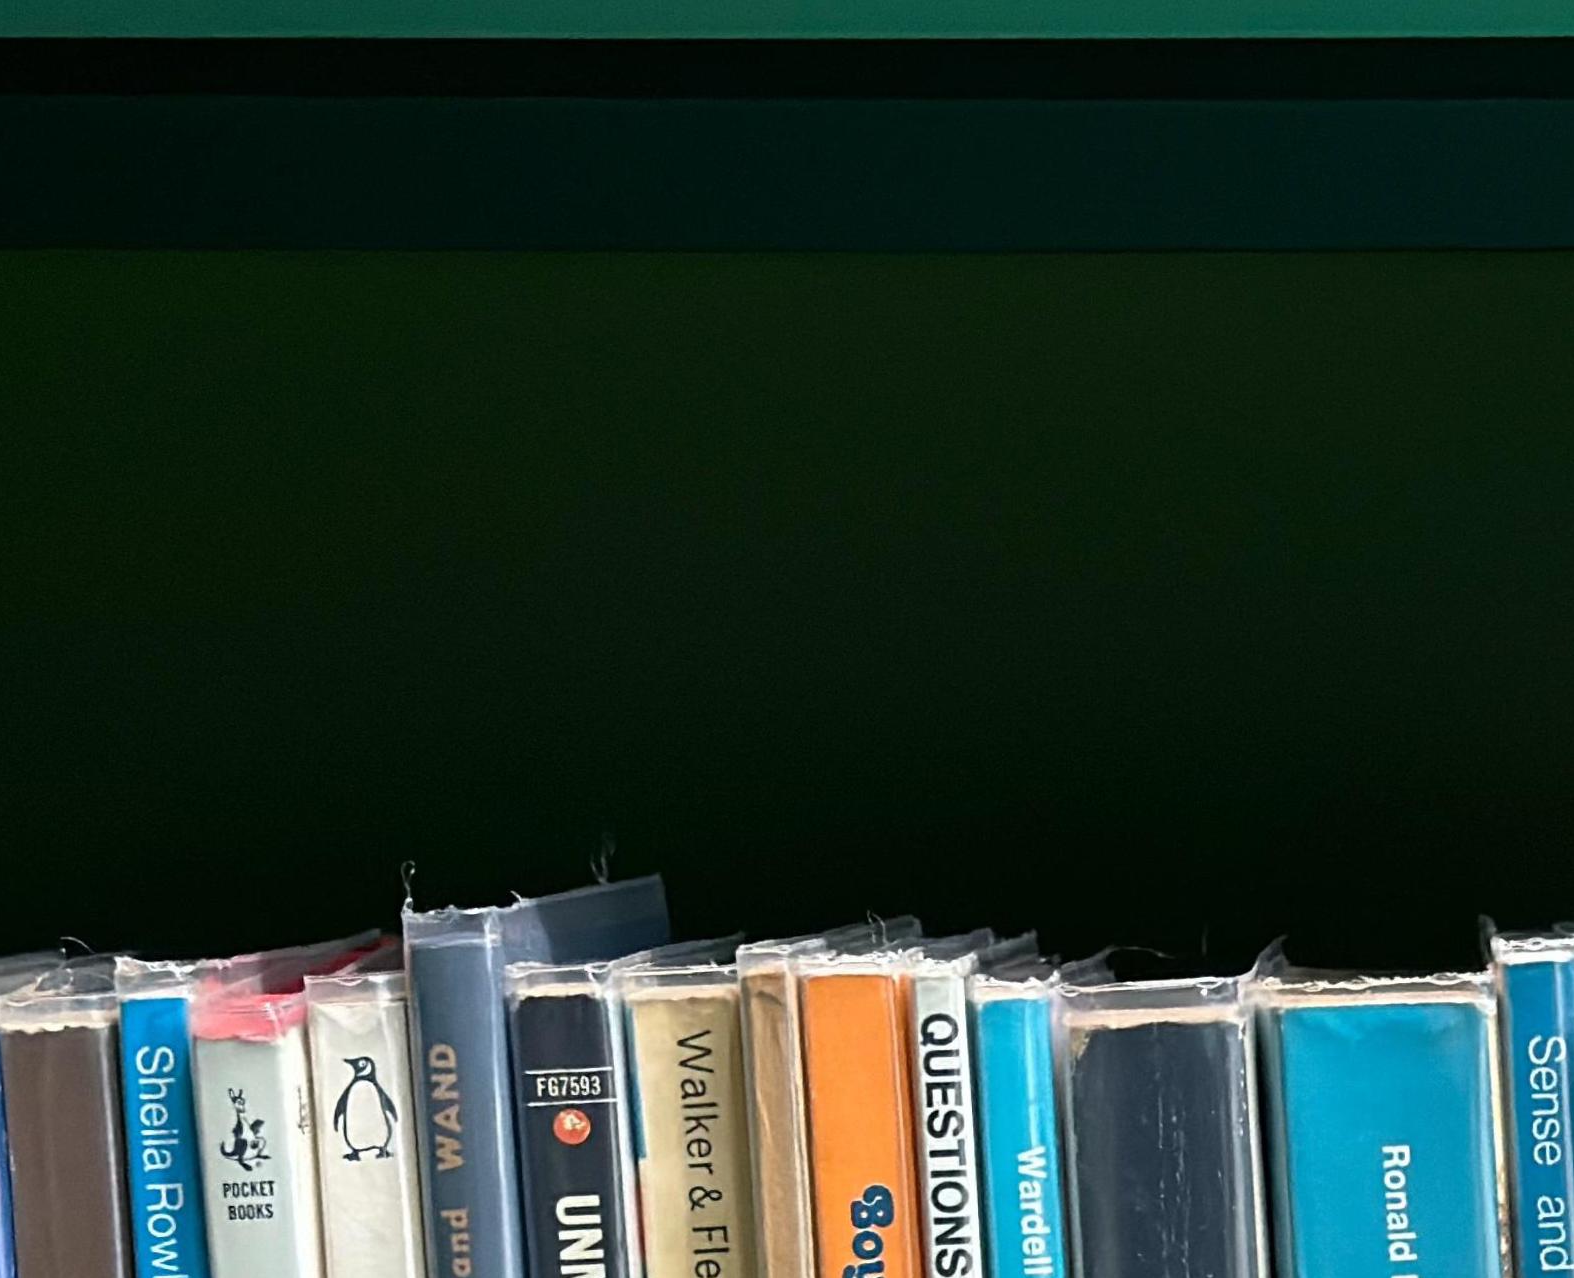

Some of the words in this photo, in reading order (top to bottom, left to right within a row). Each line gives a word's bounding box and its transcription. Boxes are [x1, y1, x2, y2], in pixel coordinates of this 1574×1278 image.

[536, 1074, 601, 1097] FG7593
[677, 1031, 713, 1175] Walker
[1528, 1034, 1567, 1166] Sense
[919, 1011, 973, 1278] QUESTIONS
[222, 1180, 274, 1199] POCKET
[228, 1203, 273, 1220] BOOKS
[692, 1186, 722, 1212] &
[1382, 1144, 1417, 1262] Ronald
[1538, 1194, 1574, 1273] and
